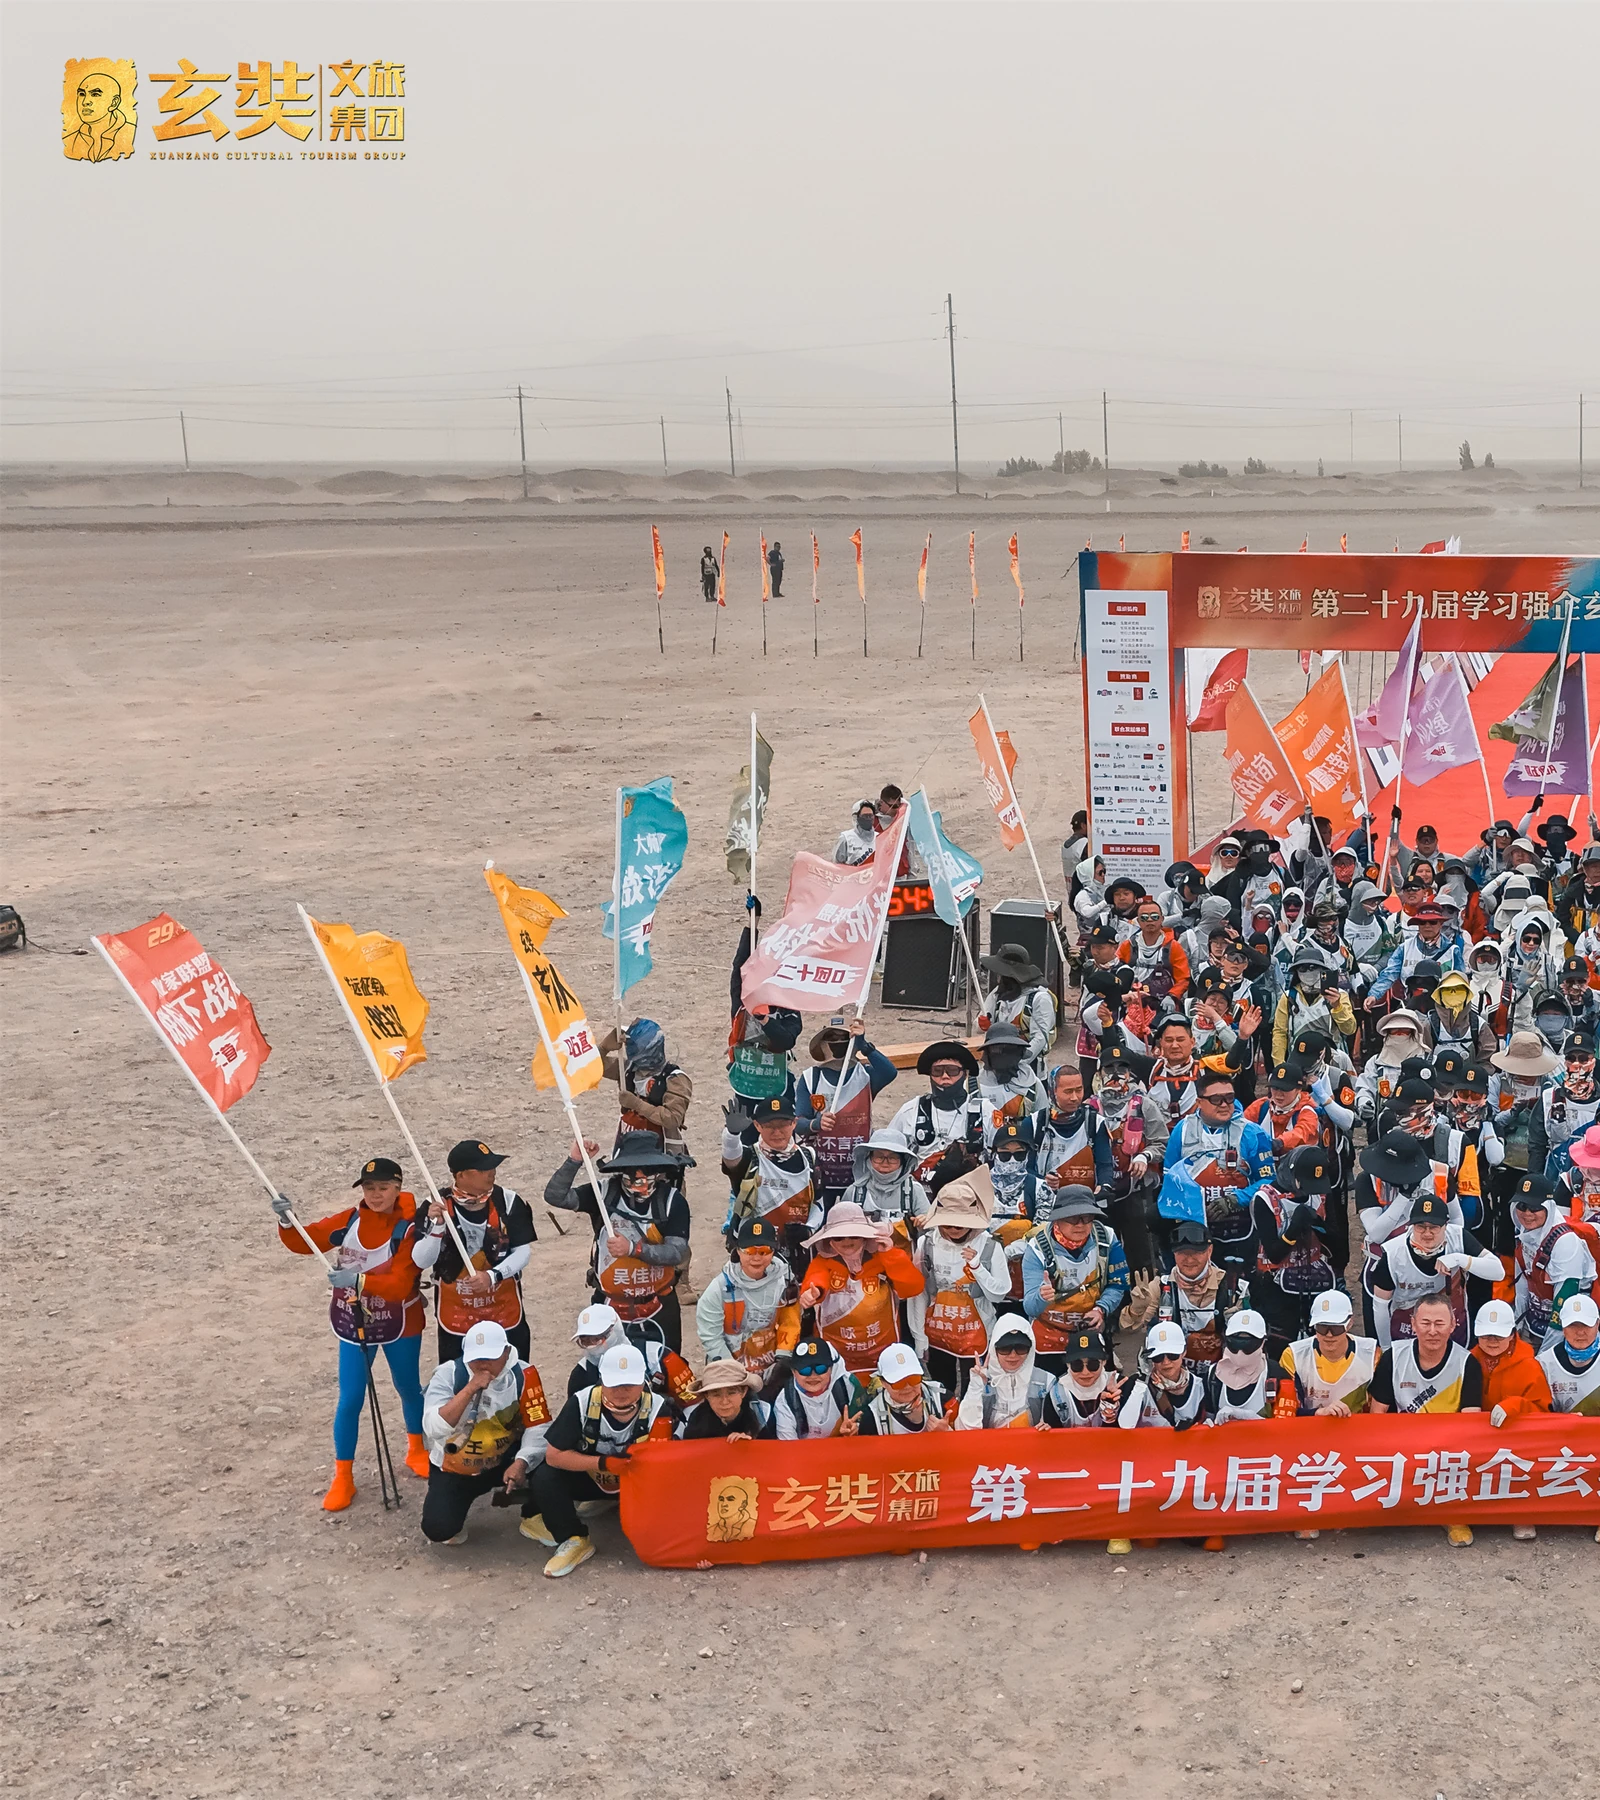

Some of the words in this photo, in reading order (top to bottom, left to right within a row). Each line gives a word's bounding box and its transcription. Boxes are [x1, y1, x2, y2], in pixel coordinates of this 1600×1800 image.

[147, 921, 176, 949] 29
[889, 1468, 941, 1495] 文旅
[887, 1496, 939, 1524] 集团
